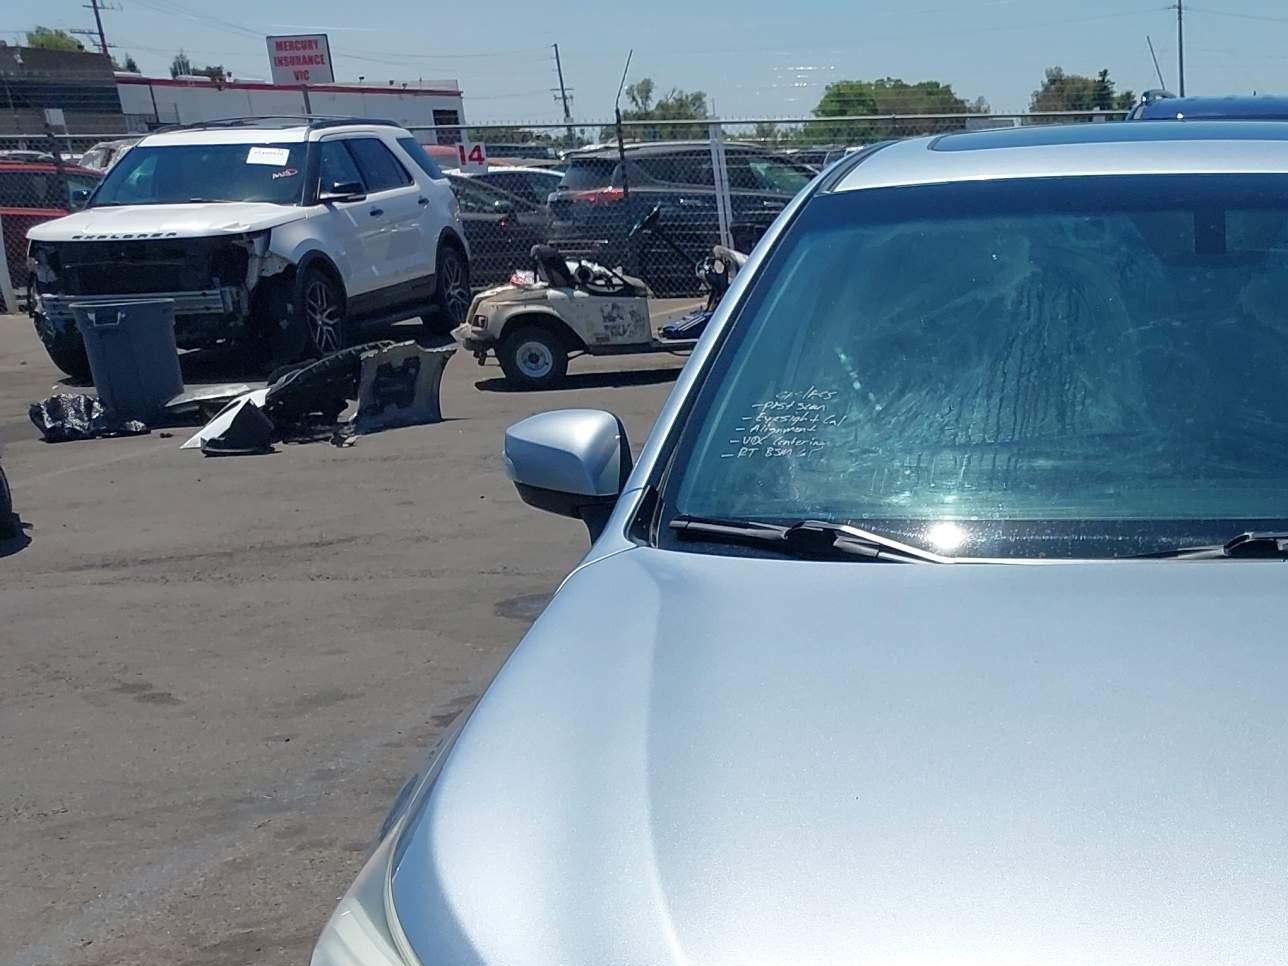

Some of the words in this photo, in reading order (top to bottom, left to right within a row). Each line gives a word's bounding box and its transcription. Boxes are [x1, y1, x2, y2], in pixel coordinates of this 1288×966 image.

[275, 39, 319, 51] MERCURY
[273, 54, 326, 67] INSURANCE
[459, 144, 485, 165] 14
[72, 232, 177, 240] EXPLORER
